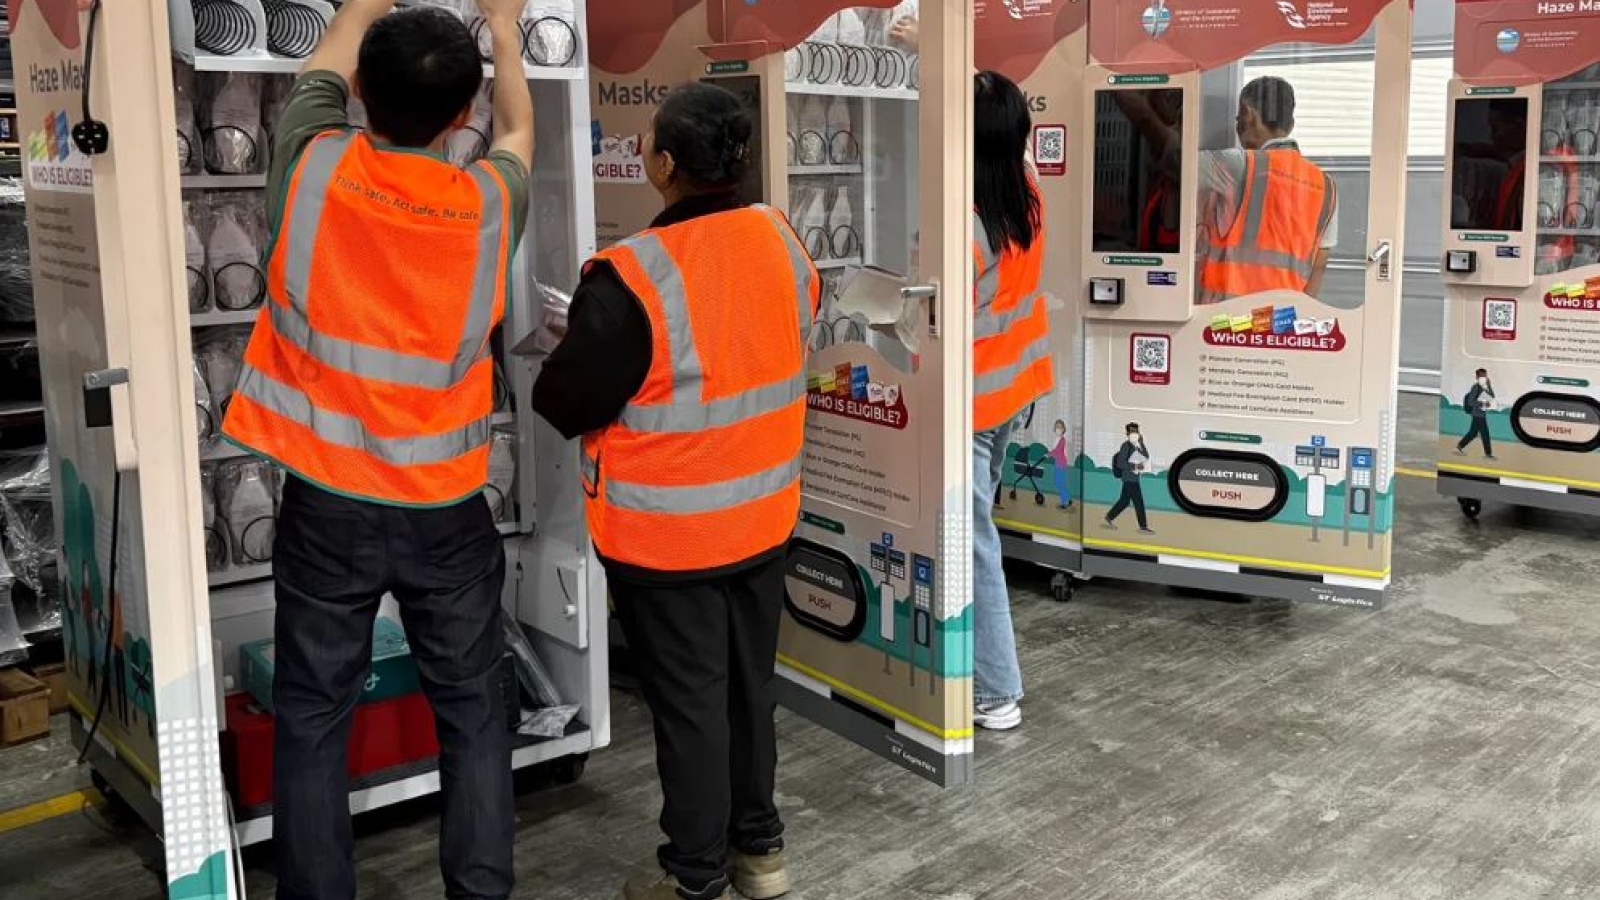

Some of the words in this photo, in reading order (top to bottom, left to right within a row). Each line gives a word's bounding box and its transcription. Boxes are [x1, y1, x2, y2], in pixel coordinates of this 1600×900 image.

[1537, 2, 1574, 14] Haze
[28, 63, 59, 93] Haze
[1551, 297, 1580, 307] WHO
[1583, 298, 1594, 309] IS
[1212, 332, 1247, 344] WHO
[1251, 334, 1262, 345] IS
[1266, 334, 1337, 348] ELIGIBLE?
[807, 393, 833, 409] WHO
[835, 397, 845, 412] IS
[847, 400, 901, 425] ELIGIBLE?
[1546, 424, 1572, 435] PUSH
[1195, 468, 1234, 478] COLLECT
[1235, 471, 1260, 481] HERE
[1211, 489, 1242, 501] PUSH
[796, 563, 825, 581] COLLECT
[825, 574, 844, 589] HERE
[808, 592, 832, 611] PUSH
